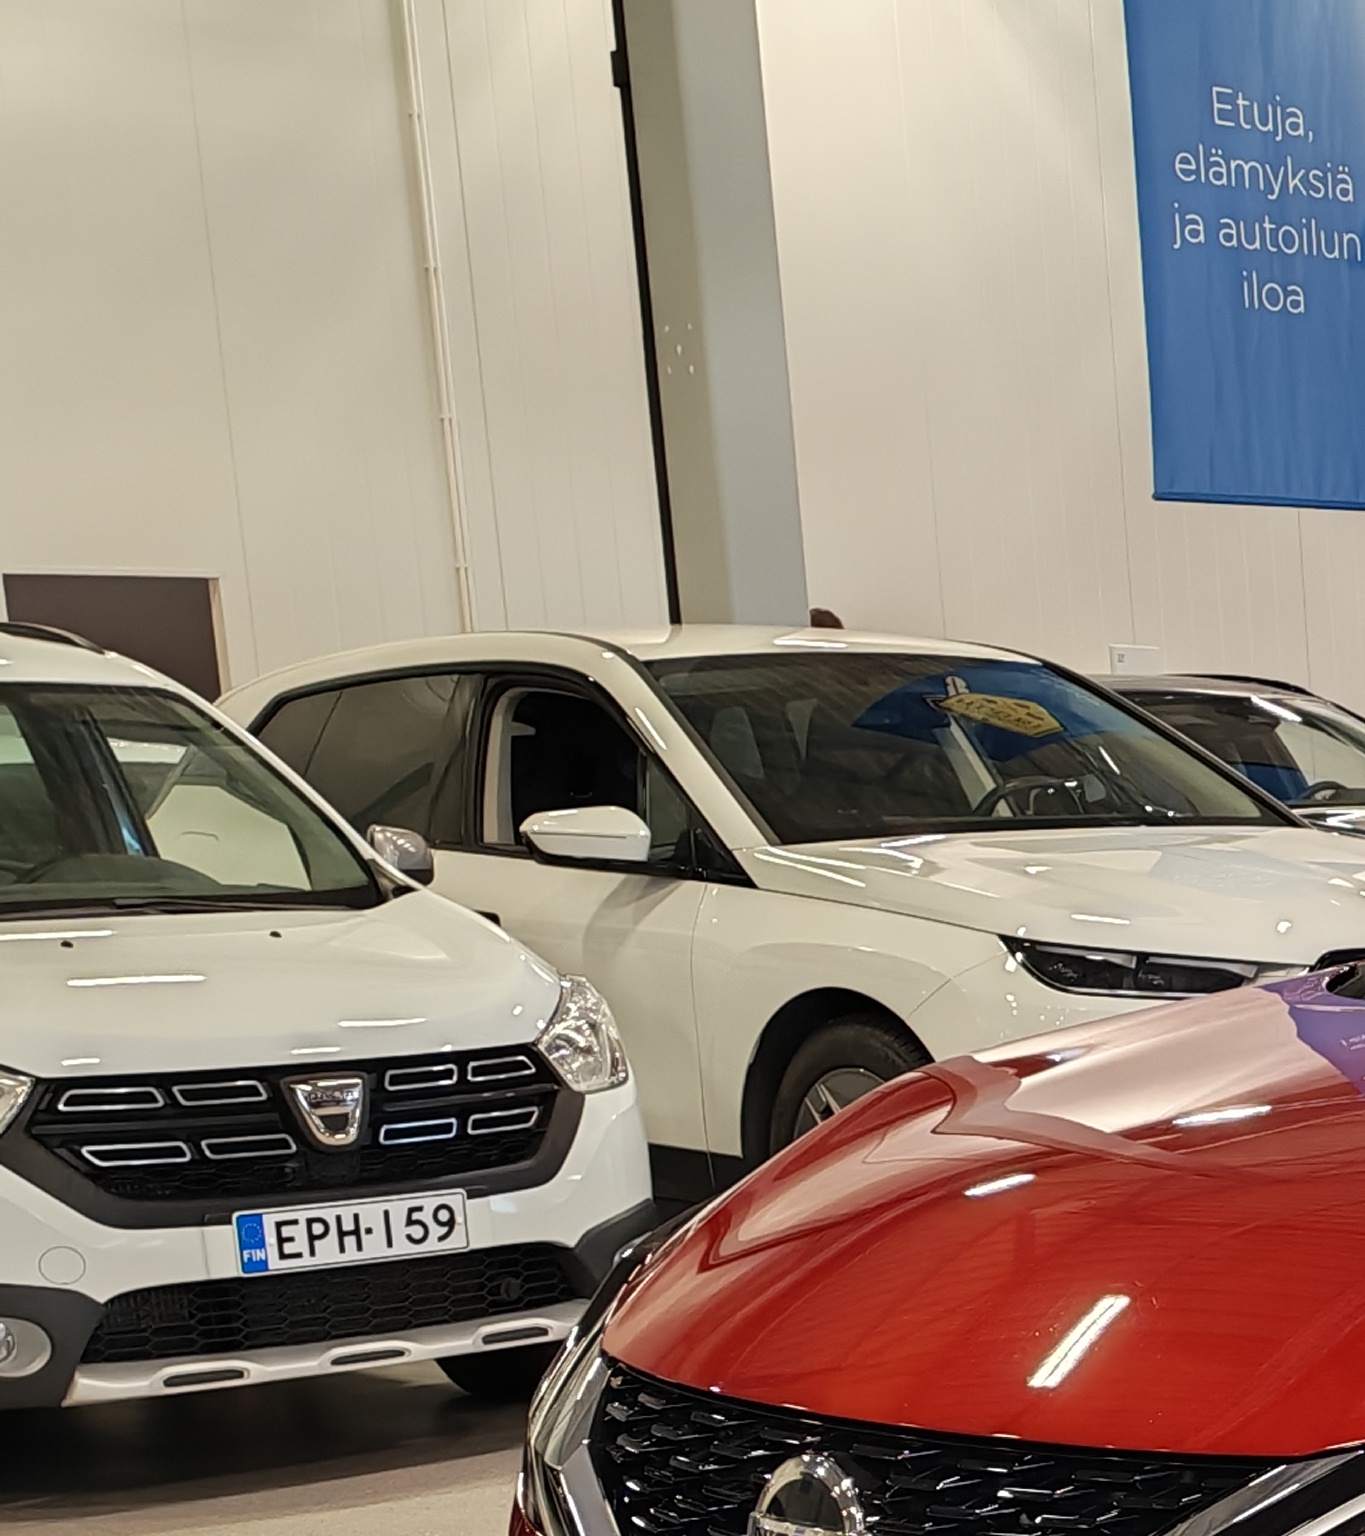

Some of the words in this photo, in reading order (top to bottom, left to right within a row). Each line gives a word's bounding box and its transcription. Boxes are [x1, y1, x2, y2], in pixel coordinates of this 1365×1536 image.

[1211, 86, 1314, 143] Etuja,
[1174, 143, 1354, 202] elämyksiä
[1172, 202, 1205, 250] ja
[1218, 214, 1363, 262] autoilun
[1242, 270, 1306, 314] iloa
[242, 1248, 266, 1263] FIN
[273, 1203, 457, 1261] EPH-159
